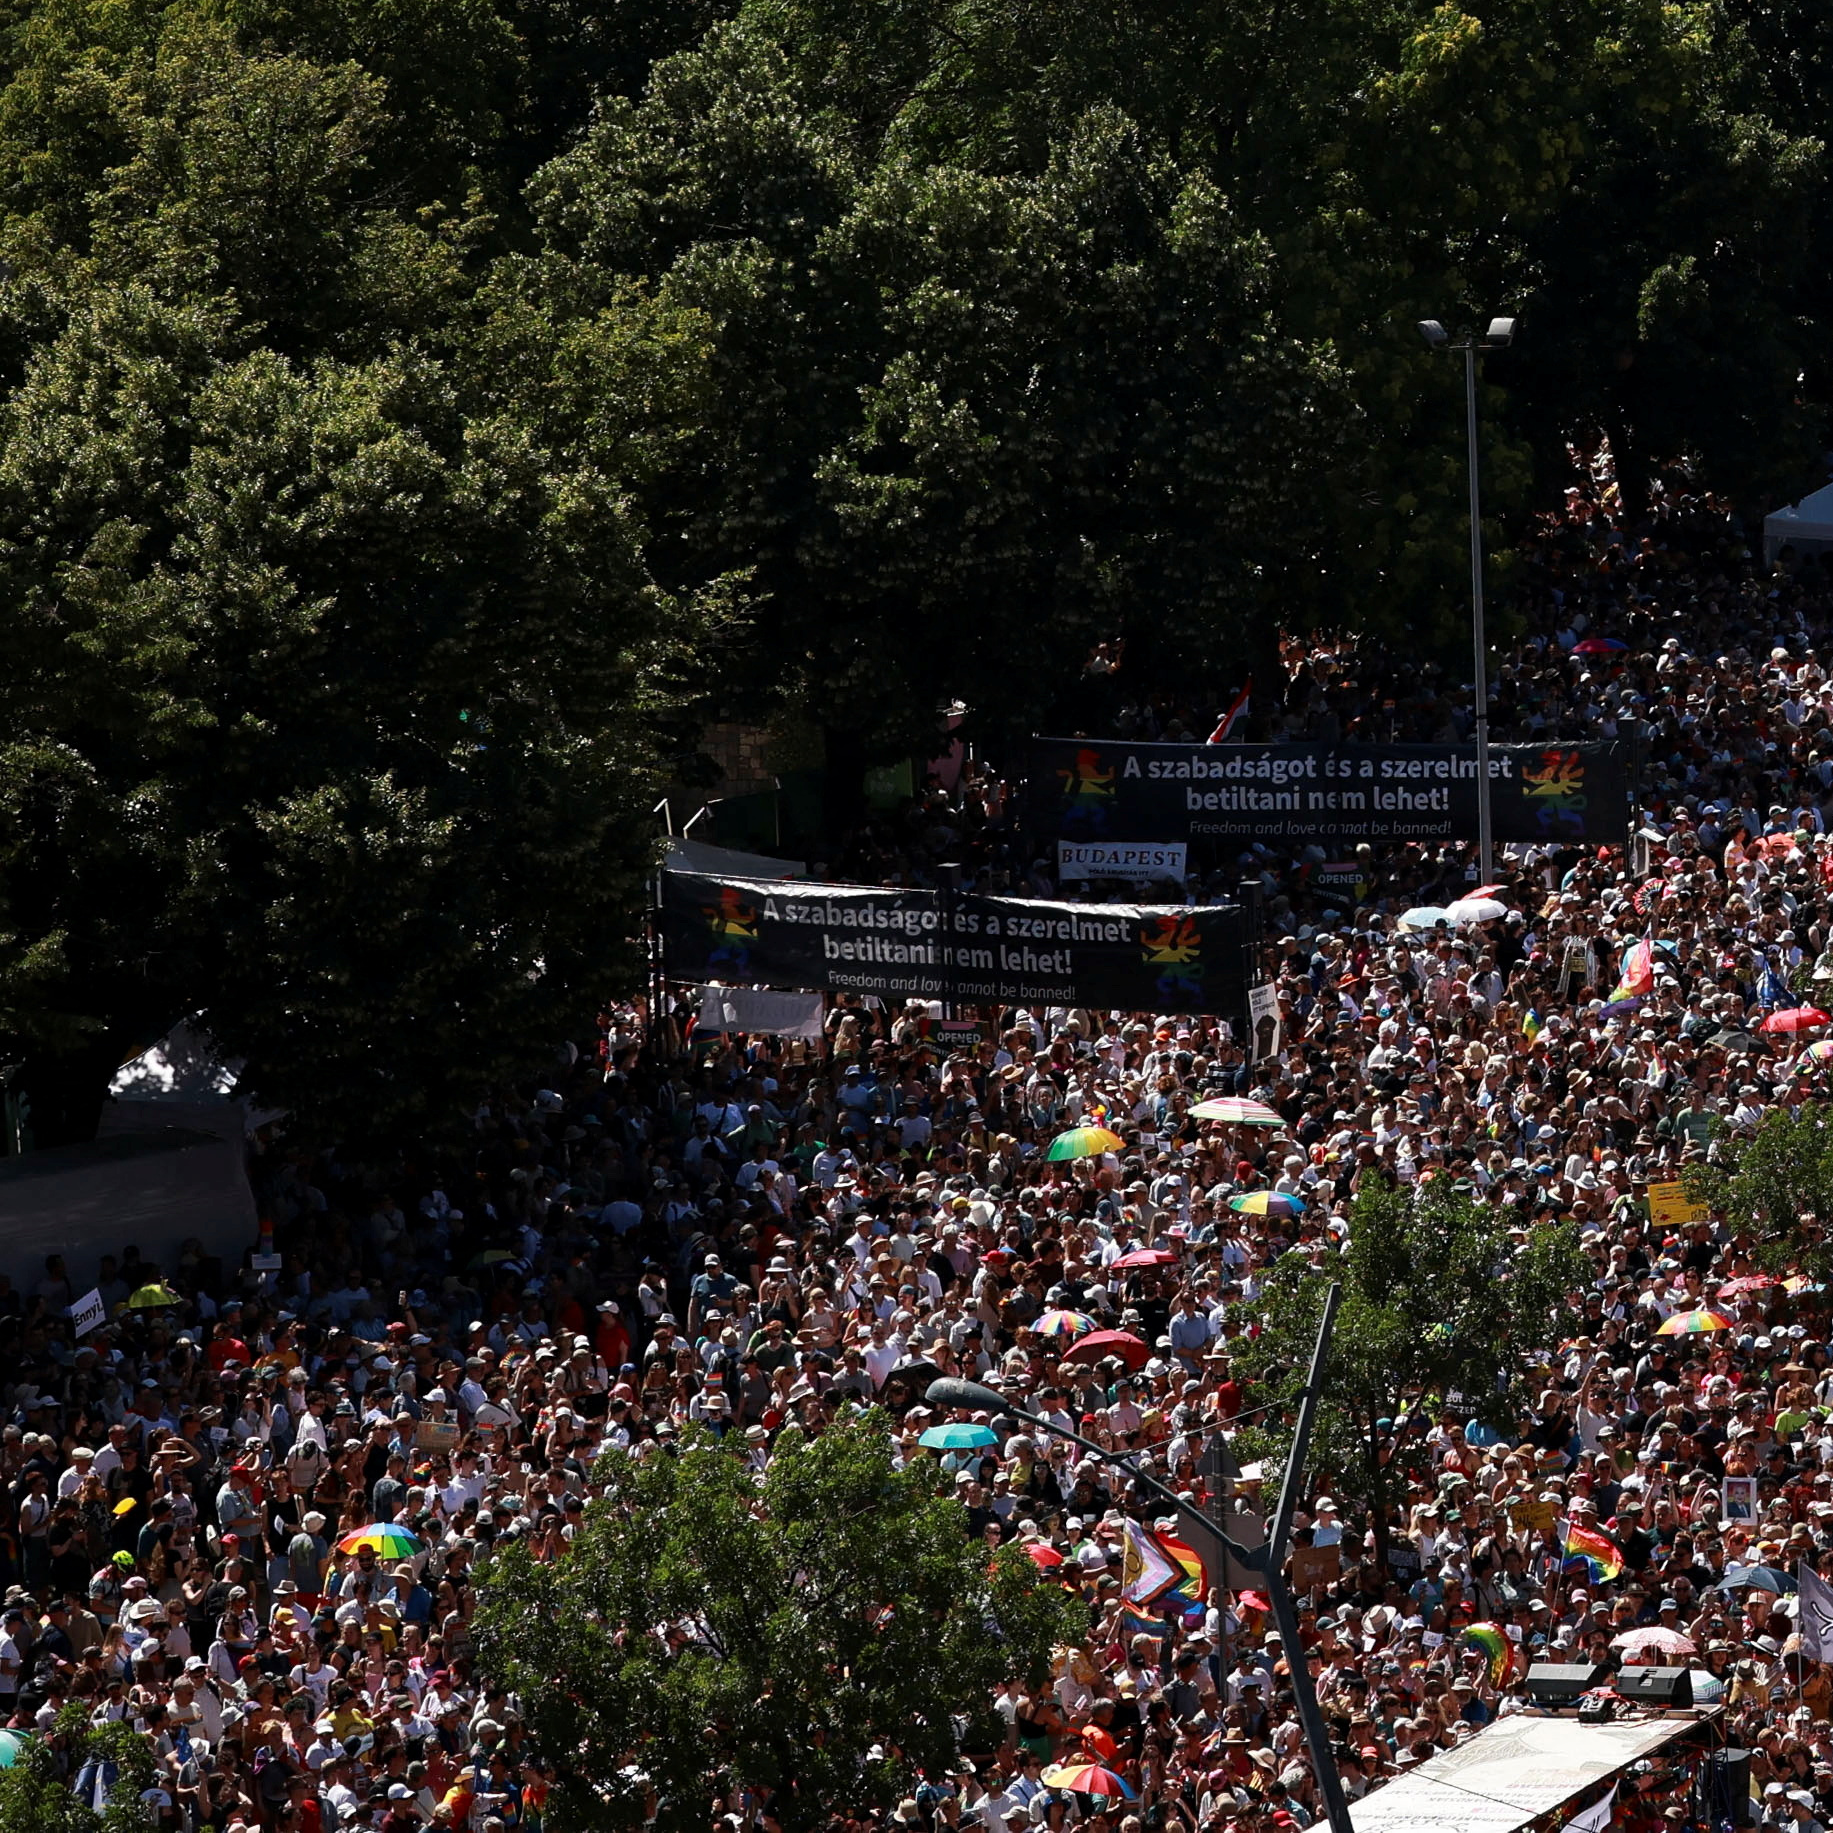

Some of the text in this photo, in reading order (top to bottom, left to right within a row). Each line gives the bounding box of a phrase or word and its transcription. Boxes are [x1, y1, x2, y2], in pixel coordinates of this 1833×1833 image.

[1123, 750, 1513, 784] A szabadságot és a szerelmet
[1186, 785, 1449, 811] betiltani nem lehet!
[1190, 820, 1250, 834] Freedom
[1254, 820, 1284, 835] and
[1286, 820, 1317, 835] love
[1371, 820, 1389, 835] be
[1394, 821, 1452, 835] banned!
[1061, 848, 1181, 867] BUDAPEST
[1318, 873, 1364, 885] OPENED
[763, 898, 780, 921] A
[954, 903, 980, 934] és
[986, 915, 1000, 935] a
[1007, 914, 1132, 943] szerelmet
[824, 934, 1073, 975] betiltani nem lehet!
[828, 970, 887, 989] Freedom
[891, 975, 917, 991] and
[951, 982, 997, 997] annot
[1000, 982, 1016, 997] be
[1020, 984, 1077, 1001] banned!
[937, 1032, 981, 1044] OPENED
